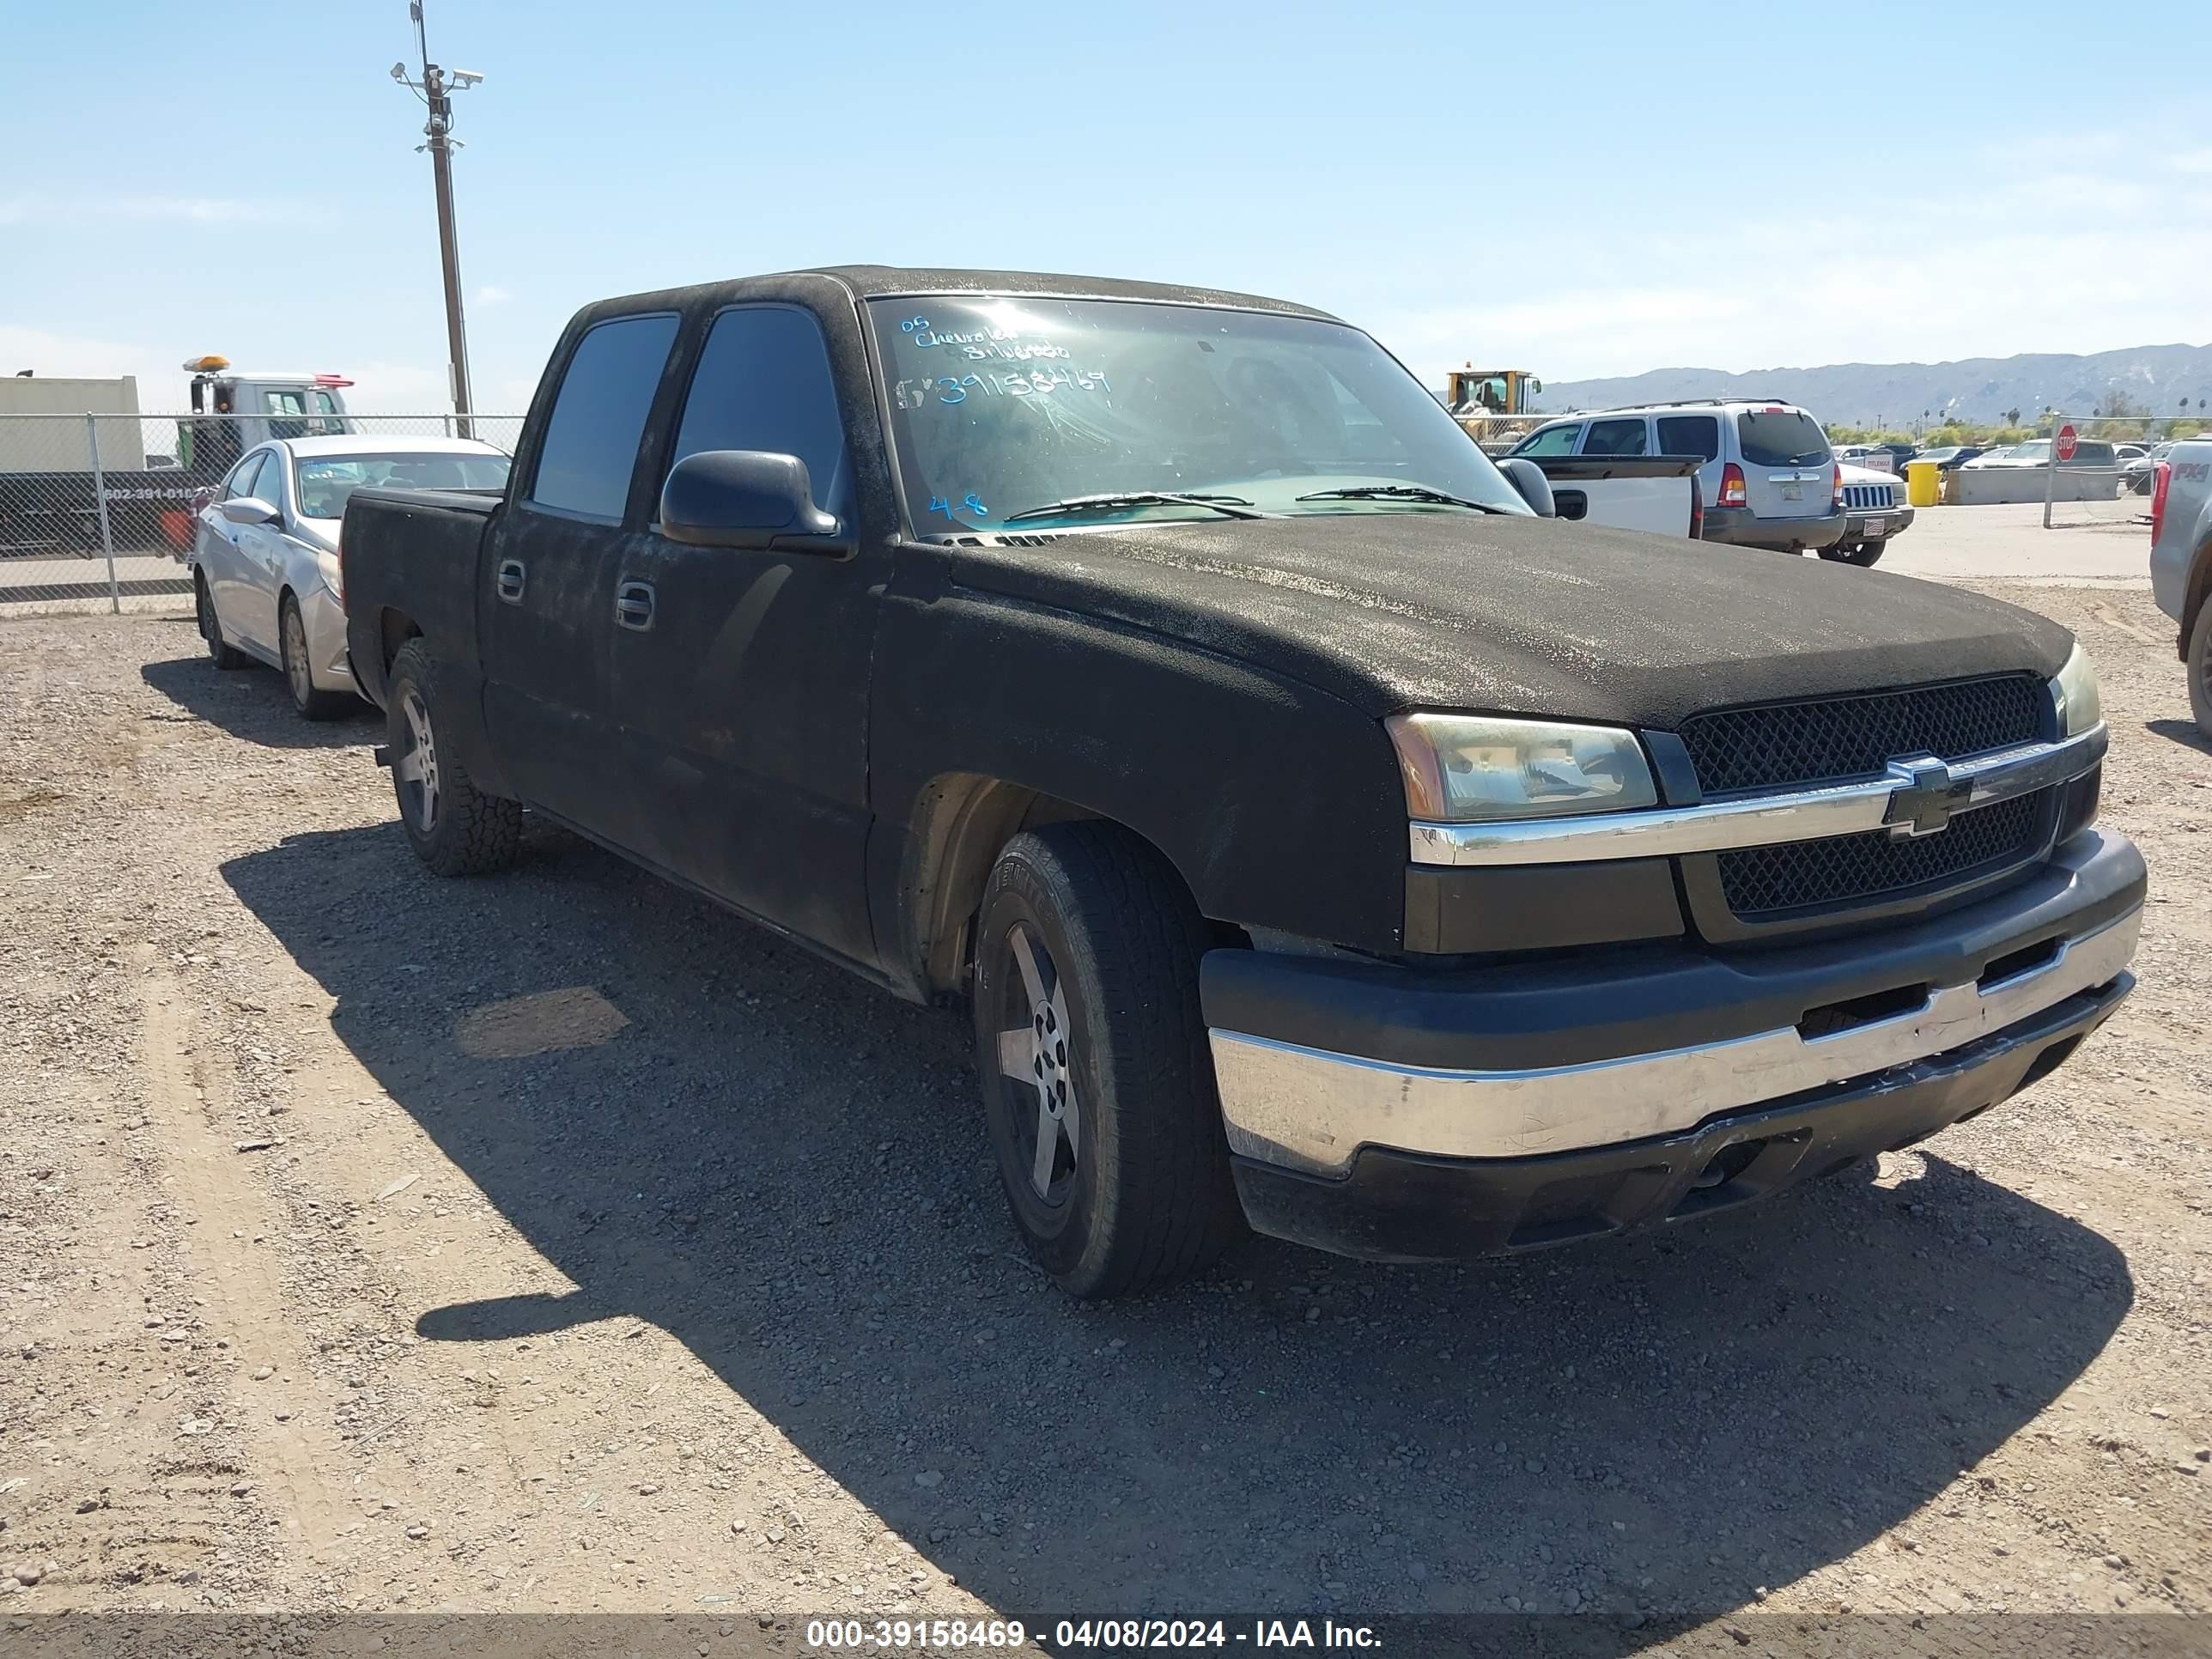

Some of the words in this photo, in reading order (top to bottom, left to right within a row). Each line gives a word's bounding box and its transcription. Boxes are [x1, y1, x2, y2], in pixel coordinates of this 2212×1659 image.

[902, 315, 930, 333] 05
[938, 367, 1111, 404] 39158469
[2058, 435, 2075, 450] STOP
[2173, 463, 2210, 483] FX4
[103, 488, 192, 500] 602-391-010
[928, 494, 988, 520] 4-8
